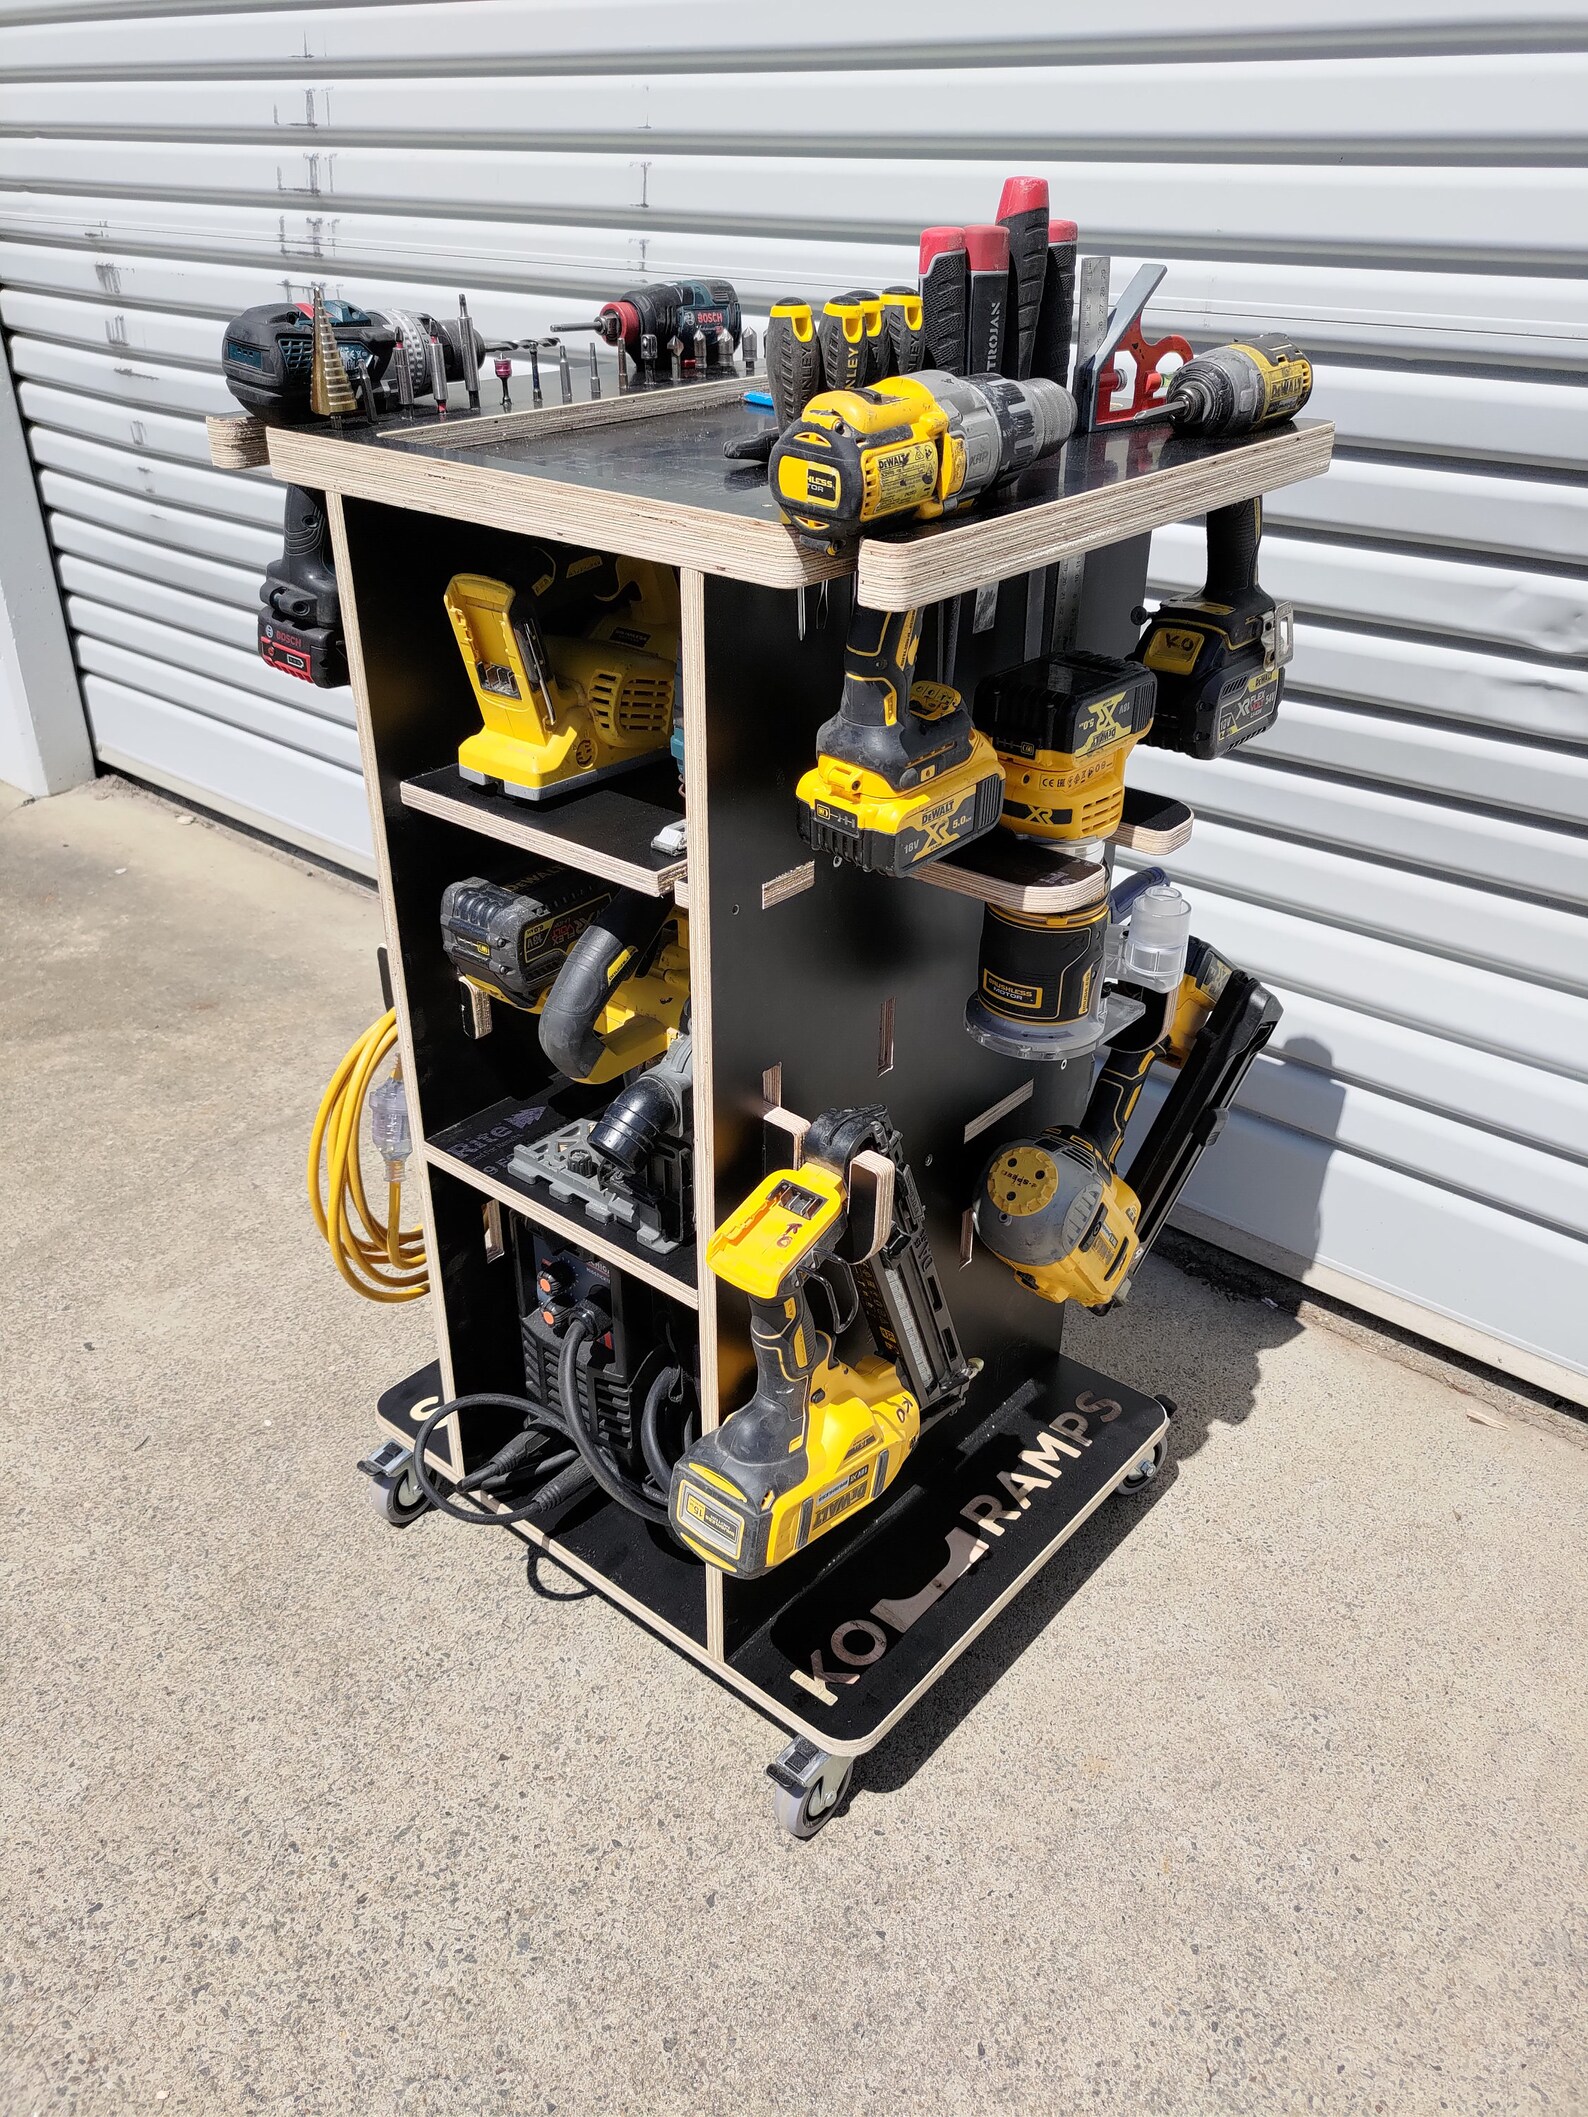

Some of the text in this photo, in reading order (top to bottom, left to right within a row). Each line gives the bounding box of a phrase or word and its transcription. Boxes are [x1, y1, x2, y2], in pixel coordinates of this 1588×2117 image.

[697, 312, 723, 323] BOSCH
[986, 302, 1000, 371] TROJAN
[276, 630, 302, 647] BOSCH
[921, 800, 955, 826] DEWALT
[1024, 804, 1056, 826] XR
[904, 838, 920, 855] 18V
[988, 977, 1033, 997] BRUSHLESS
[993, 986, 1023, 1001] MOTOR
[960, 1390, 1123, 1537] RAMPS
[789, 1619, 887, 1706] KO
